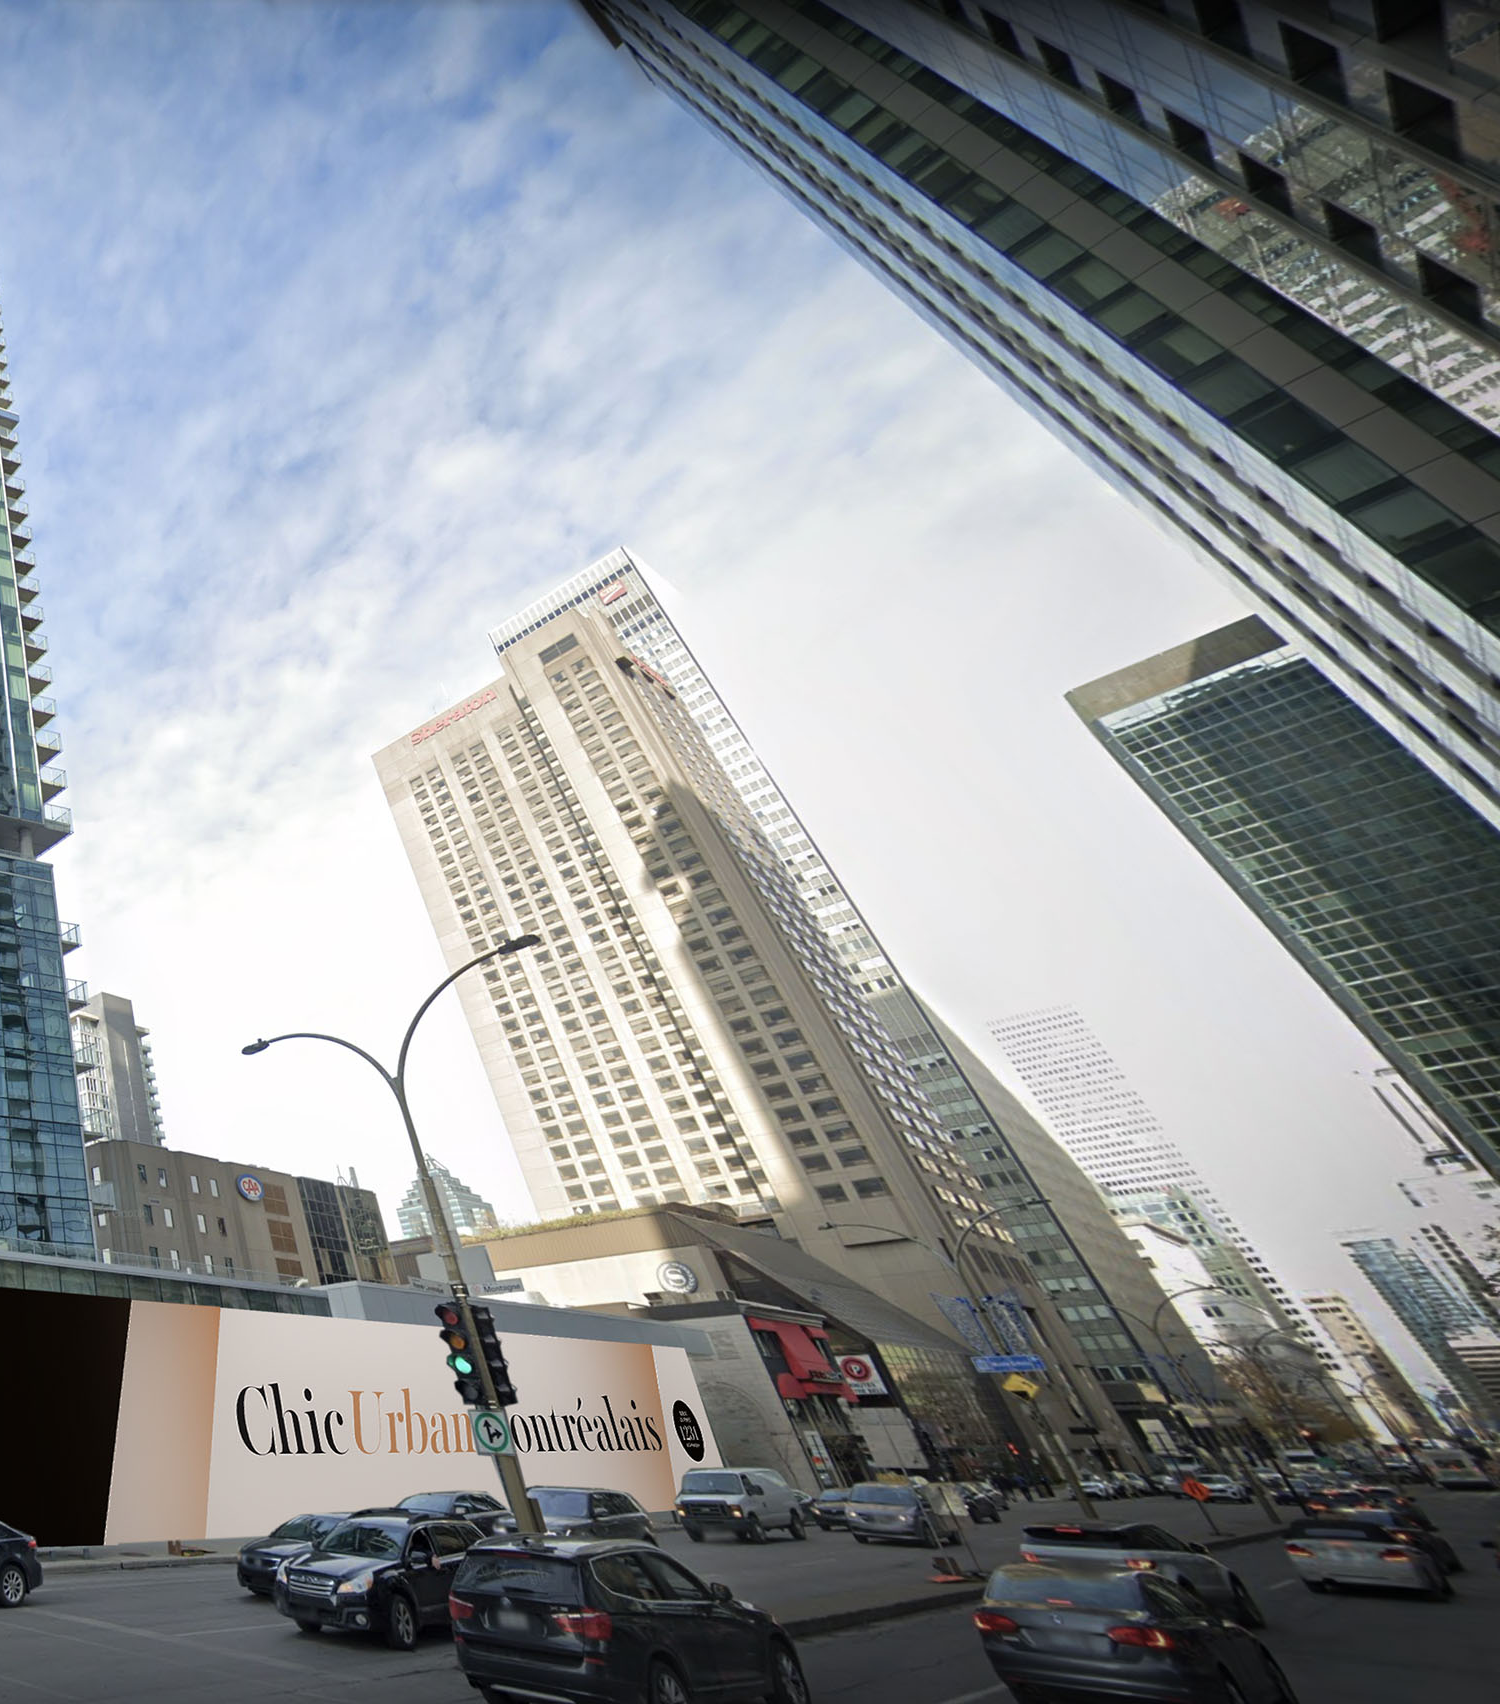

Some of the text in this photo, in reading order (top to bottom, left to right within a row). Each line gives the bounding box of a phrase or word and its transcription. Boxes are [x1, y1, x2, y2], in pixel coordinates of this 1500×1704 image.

[410, 689, 498, 747] Sheraton
[242, 1178, 260, 1195] CAA
[235, 1382, 663, 1456] Chic Urban ontréalais
